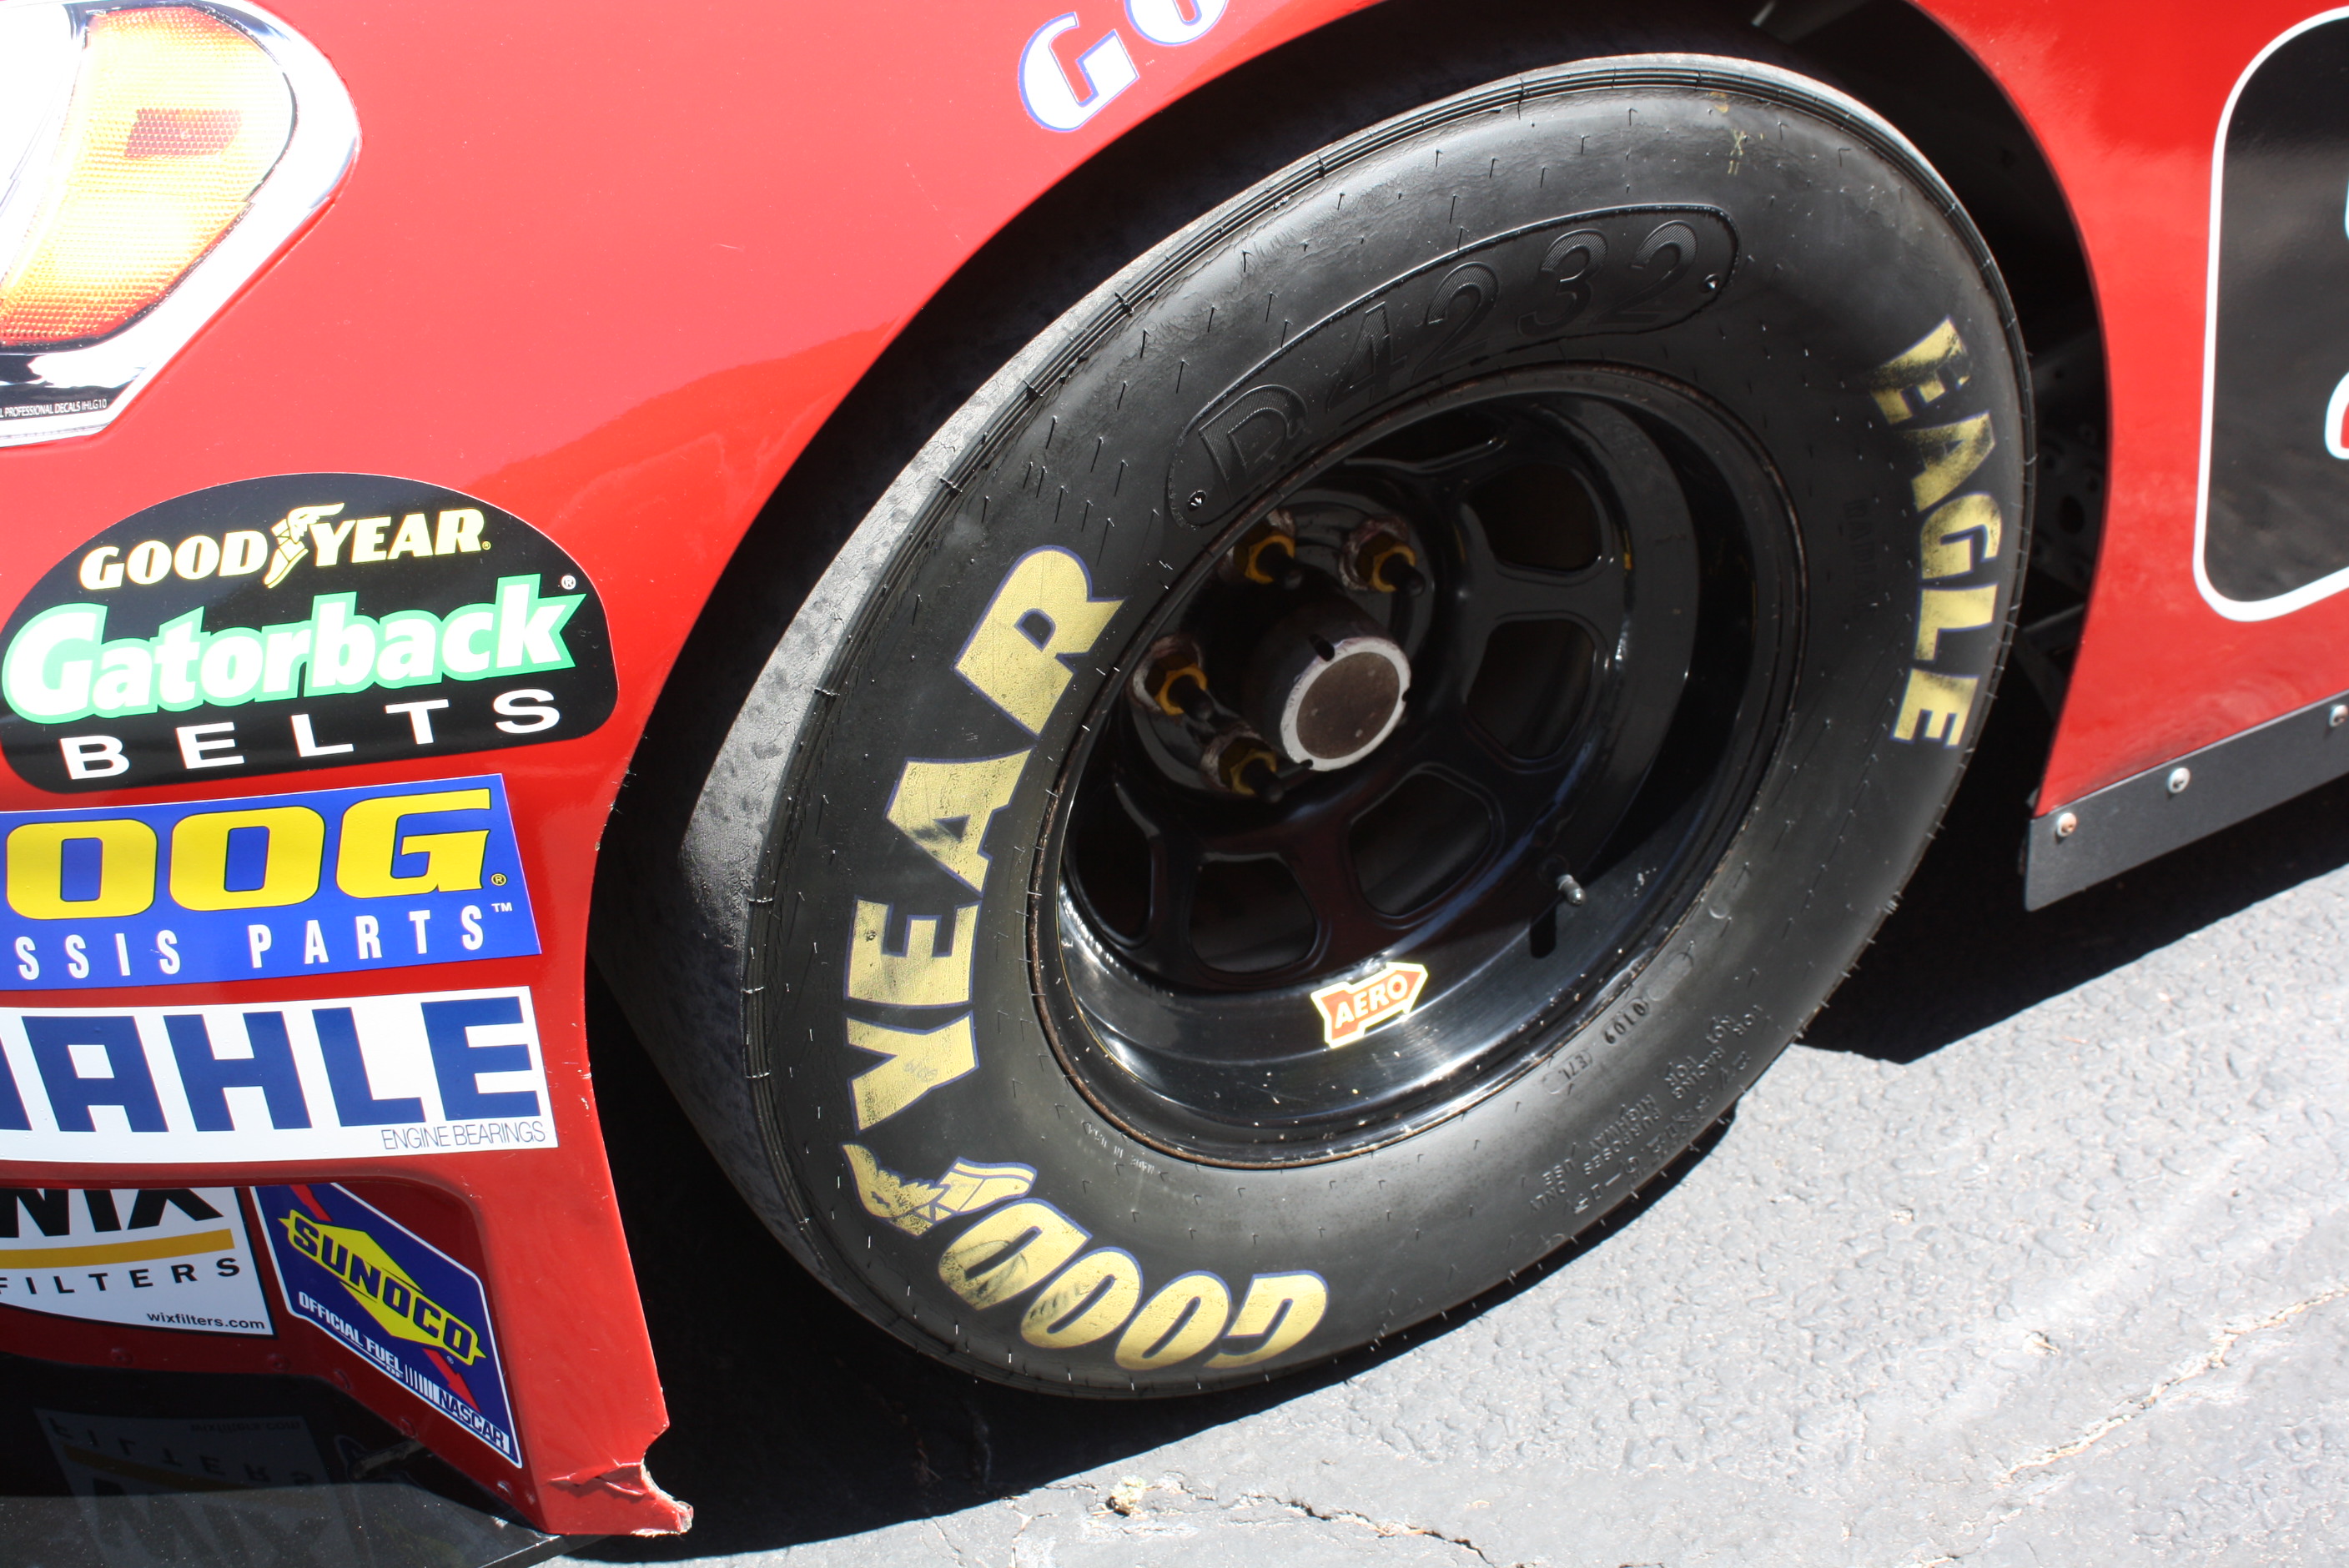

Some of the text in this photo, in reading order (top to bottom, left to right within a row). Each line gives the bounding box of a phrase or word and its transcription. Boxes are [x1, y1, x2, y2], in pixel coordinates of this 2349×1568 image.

[4, 404, 53, 417] PROFESSIONAL
[54, 401, 81, 414] DECALS
[1869, 314, 2003, 748] EAGLE
[2, 573, 586, 724] Gatorback
[59, 689, 561, 781] BELTS
[6, 788, 492, 921] OOG
[16, 928, 181, 980] SSIS
[248, 904, 484, 969] PARTS
[1335, 974, 1408, 1029] AERO
[1672, 1046, 1726, 1099] RACING
[381, 1121, 546, 1150] ENGINE BEARINGS
[1542, 1158, 1576, 1186] USE
[147, 1312, 265, 1329] wixfilters.com
[293, 1216, 475, 1363] SUNOCO
[299, 1291, 404, 1375] OFFICIAL FUEL
[439, 1388, 506, 1452] NASCAR
